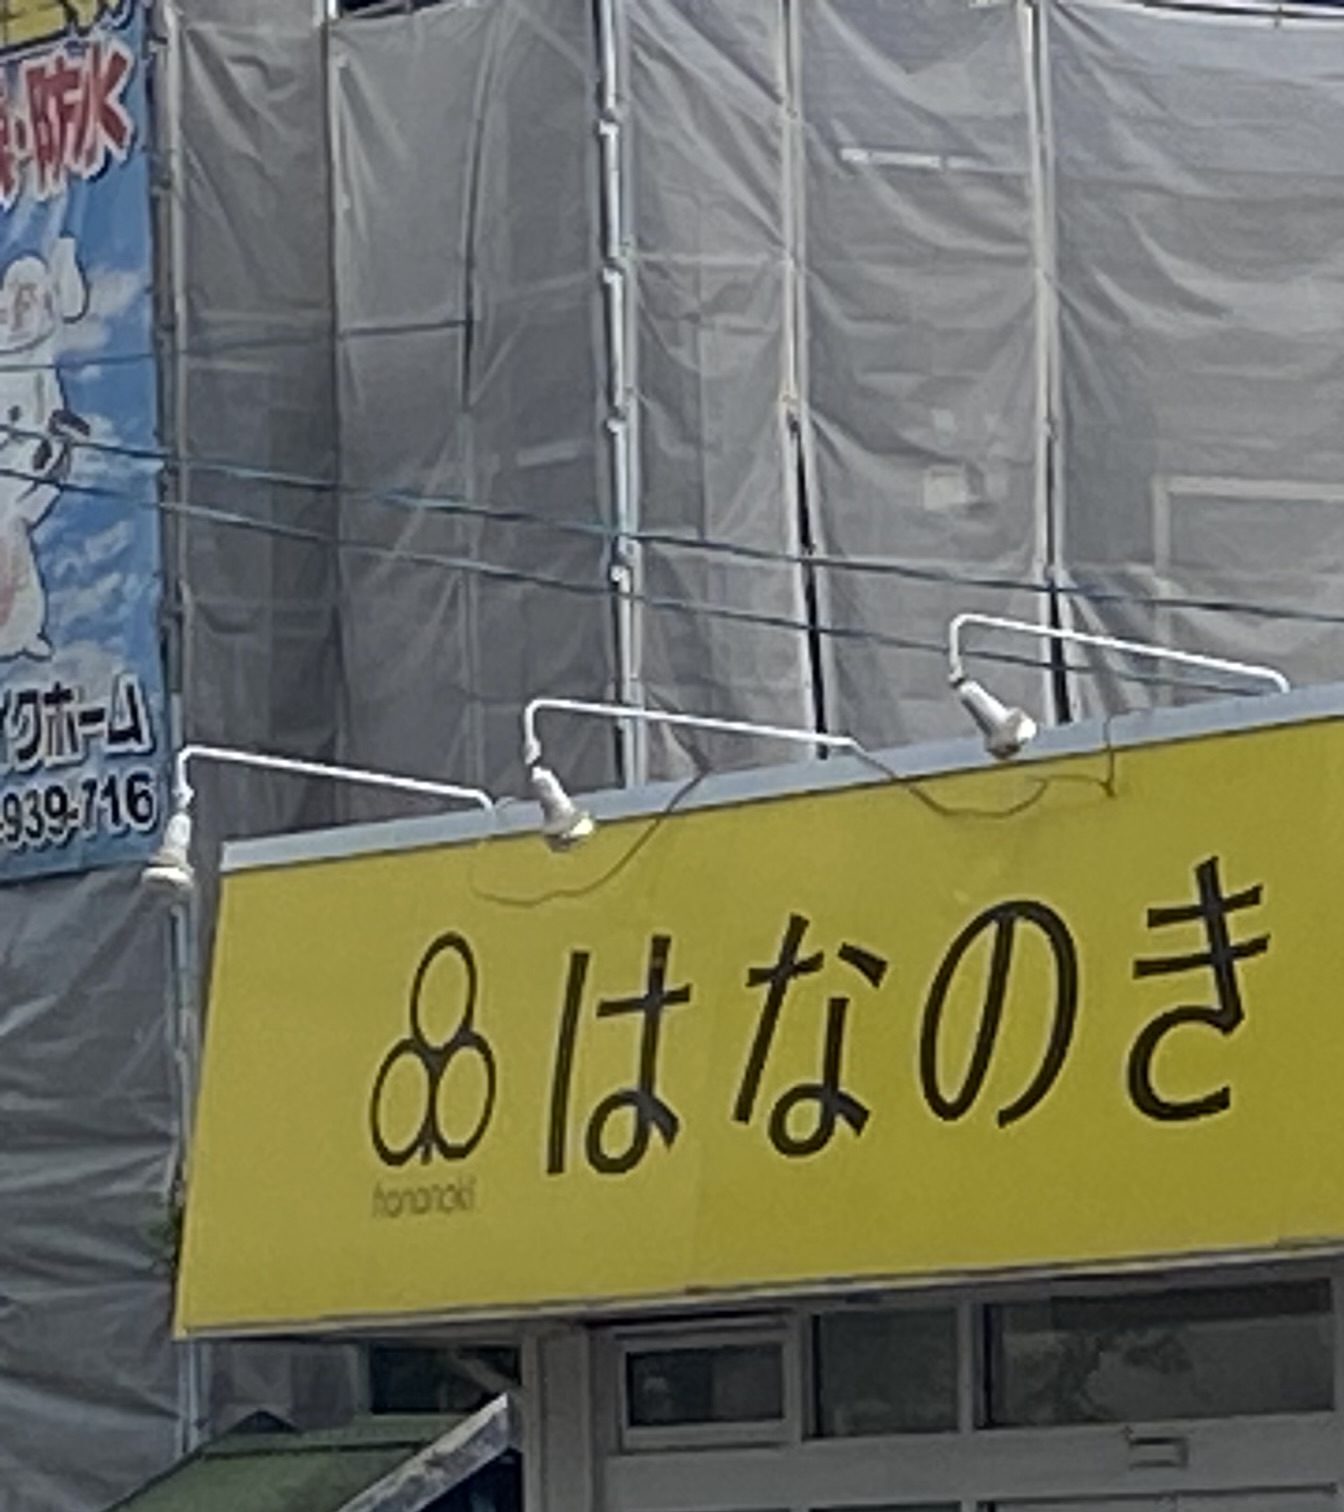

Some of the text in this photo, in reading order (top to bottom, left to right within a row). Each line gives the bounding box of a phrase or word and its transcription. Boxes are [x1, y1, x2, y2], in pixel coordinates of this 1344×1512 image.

[0, 40, 128, 198] ・防水
[545, 855, 1272, 1176] はなのき
